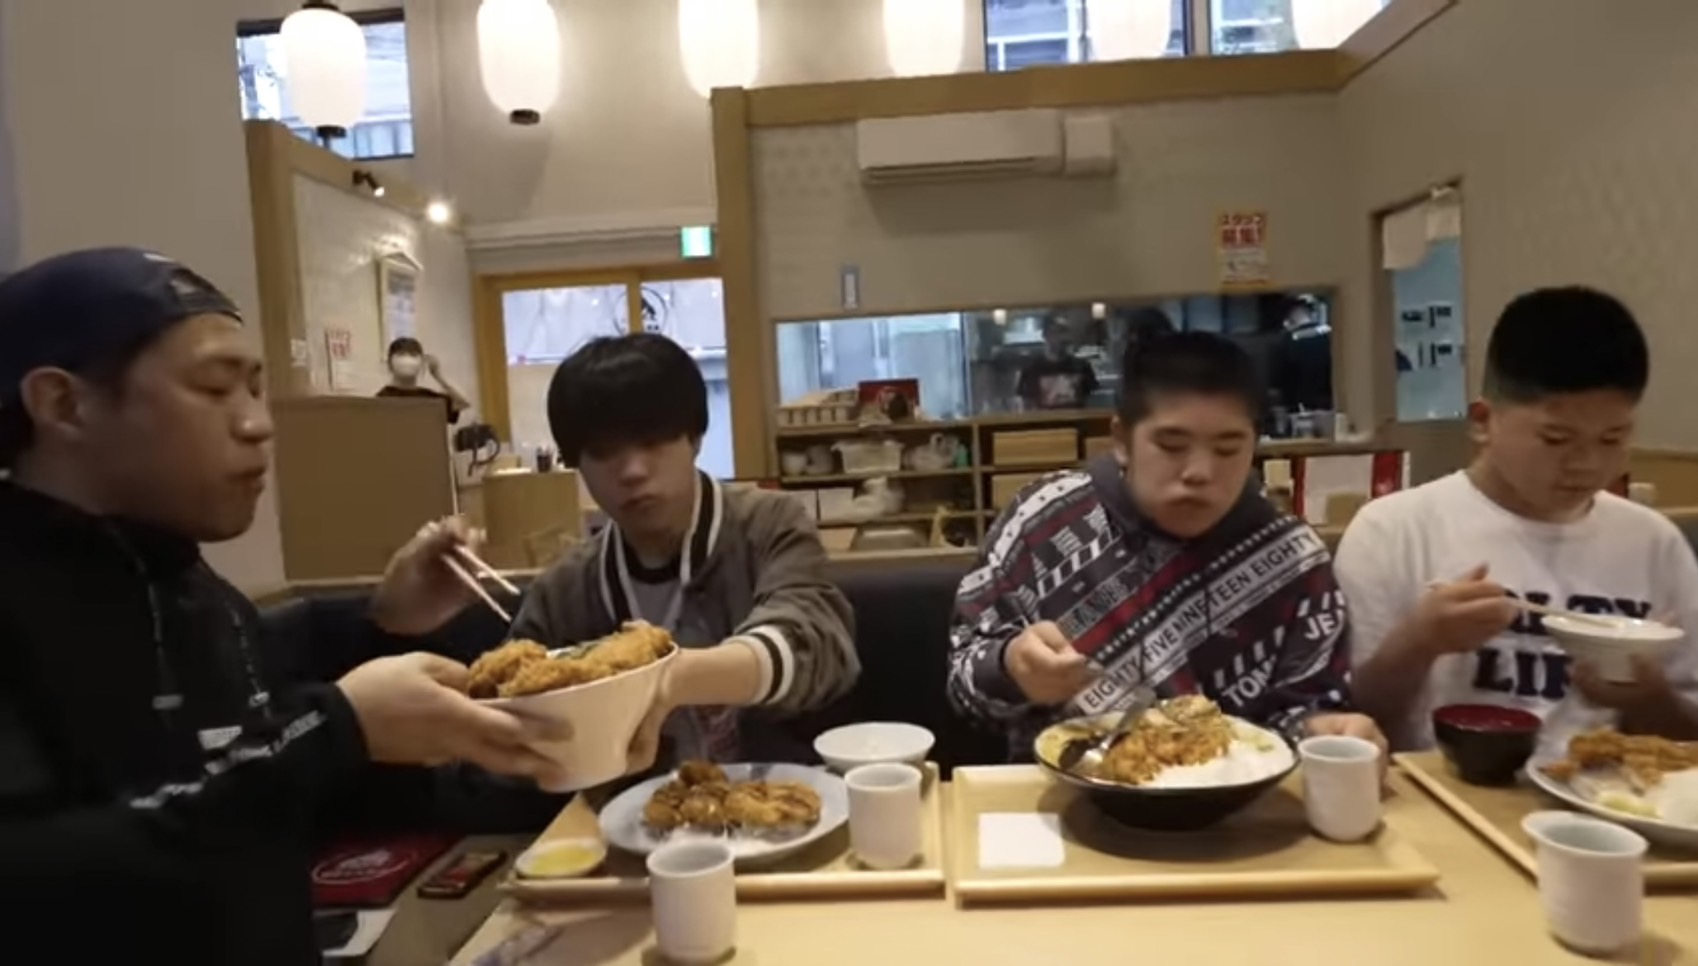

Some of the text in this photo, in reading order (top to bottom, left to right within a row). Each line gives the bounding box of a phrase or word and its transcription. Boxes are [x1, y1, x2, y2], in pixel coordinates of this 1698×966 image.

[1083, 655, 1138, 708] EIGHTY
[1143, 627, 1178, 662] FIVE
[1250, 532, 1318, 577] EIGHTY
